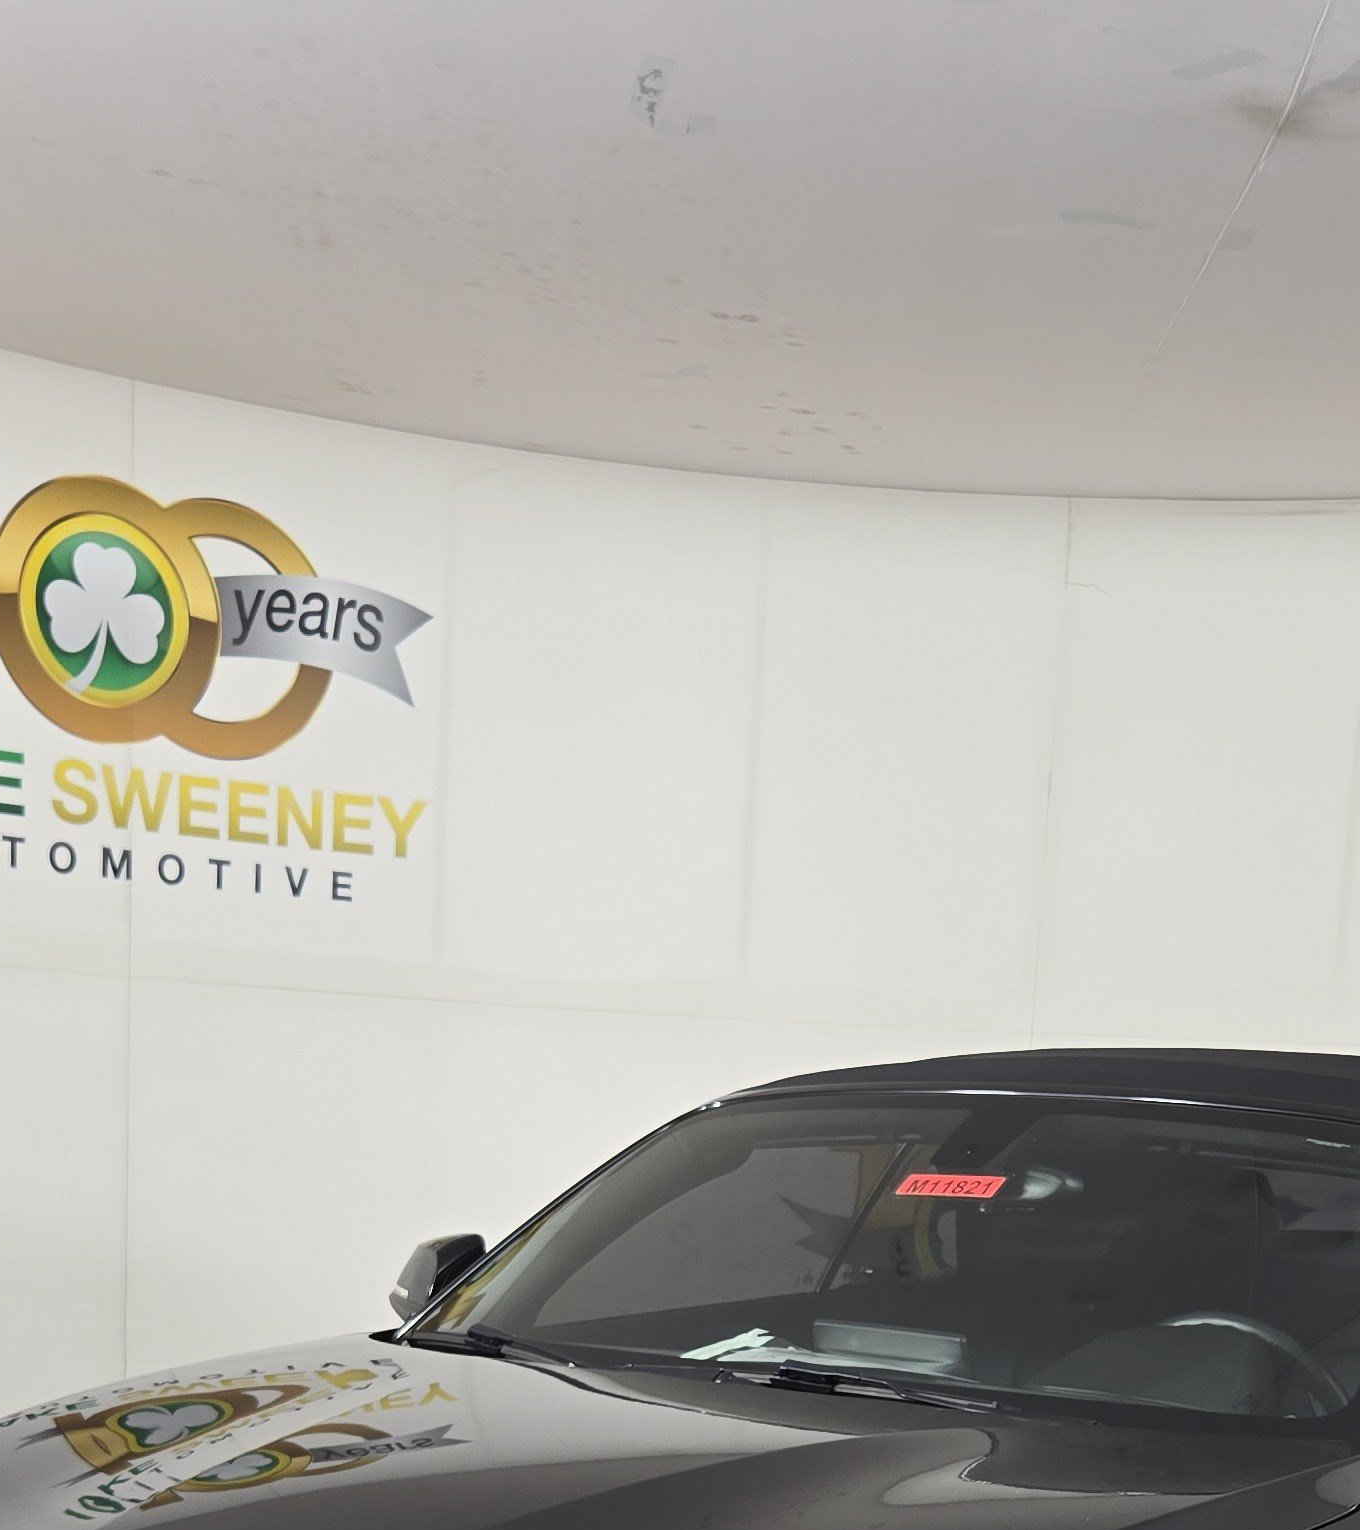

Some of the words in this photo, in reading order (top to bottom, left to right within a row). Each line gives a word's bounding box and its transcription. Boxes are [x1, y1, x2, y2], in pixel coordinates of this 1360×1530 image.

[231, 586, 384, 653] years
[51, 757, 427, 859] SWEENEY
[904, 1179, 995, 1196] M11821
